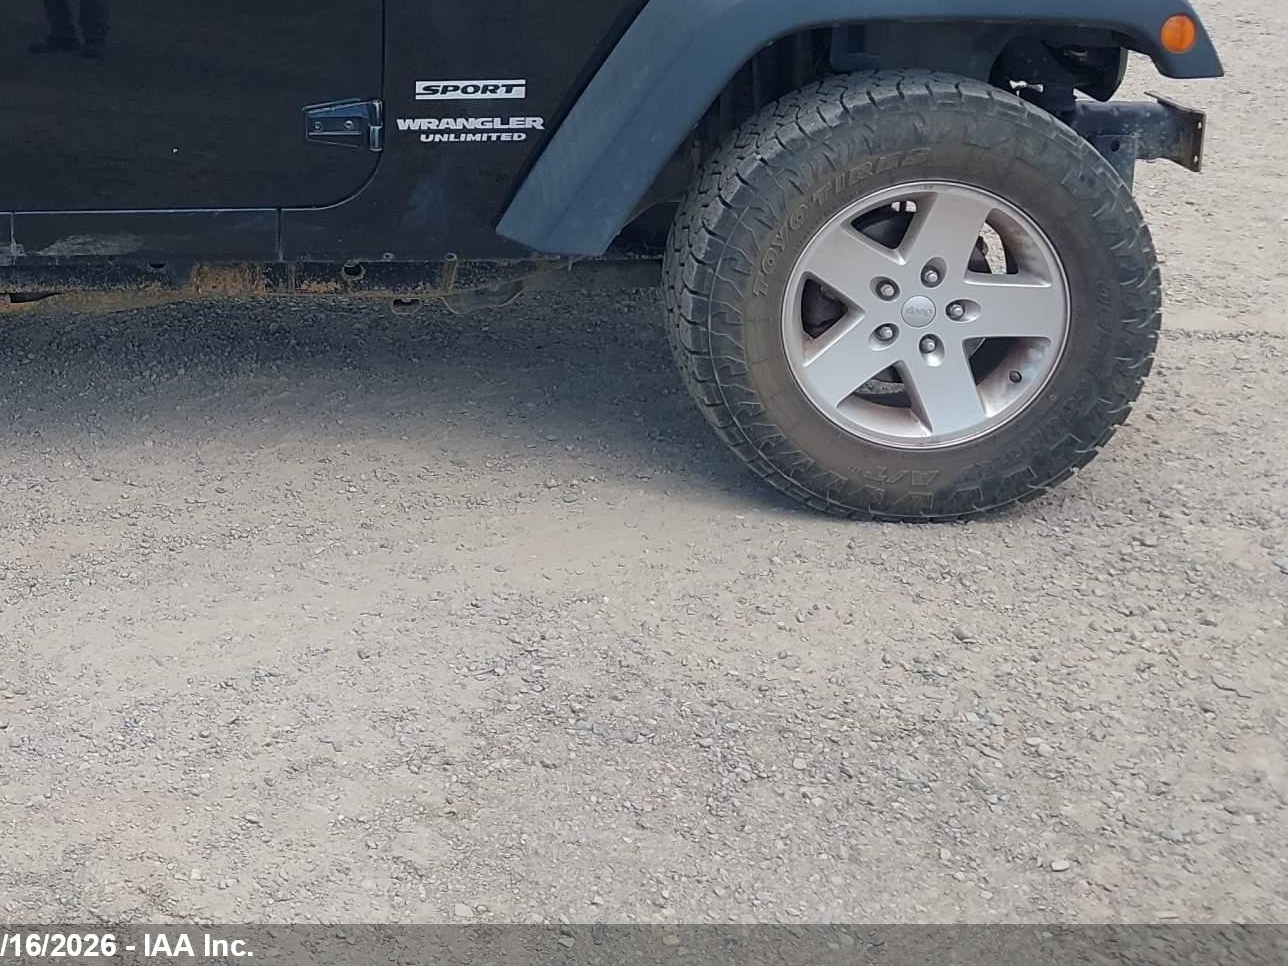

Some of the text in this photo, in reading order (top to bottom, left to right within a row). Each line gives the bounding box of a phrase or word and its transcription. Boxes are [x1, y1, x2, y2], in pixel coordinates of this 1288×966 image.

[418, 82, 525, 96] SPORT
[396, 117, 545, 130] WRANGLER
[420, 132, 527, 142] UNLIMITED
[753, 147, 931, 296] TOYO TIRES
